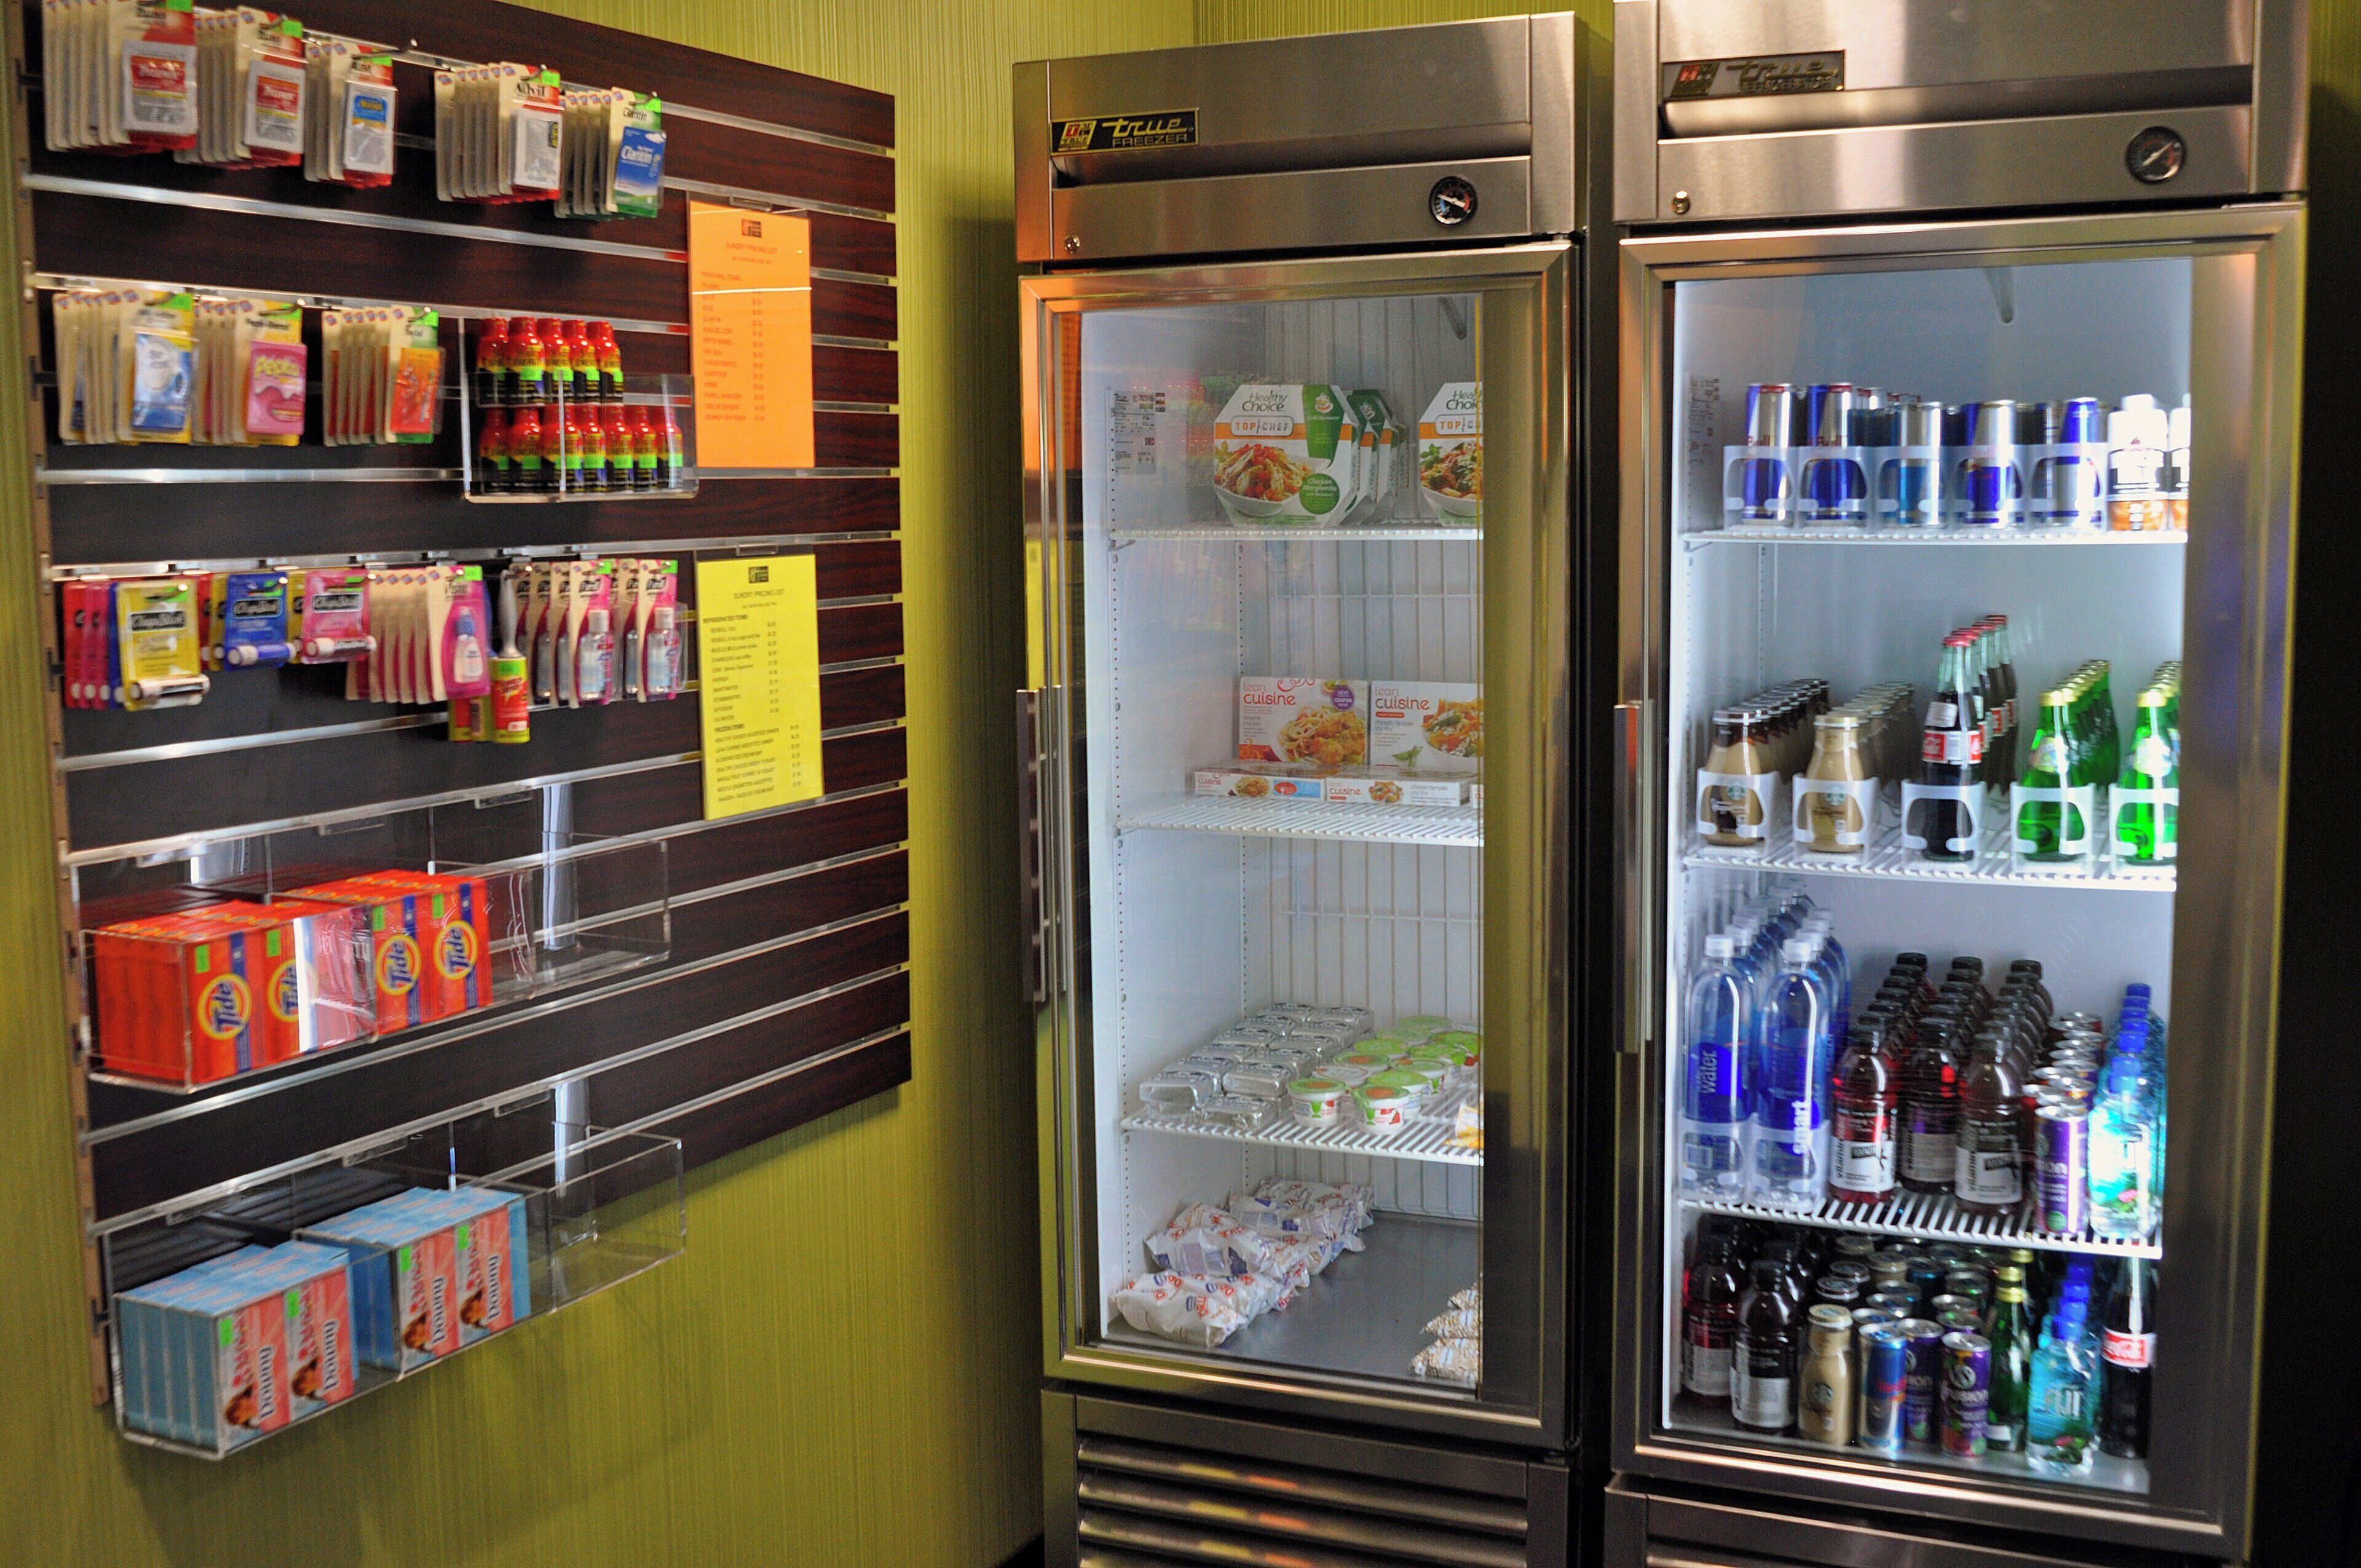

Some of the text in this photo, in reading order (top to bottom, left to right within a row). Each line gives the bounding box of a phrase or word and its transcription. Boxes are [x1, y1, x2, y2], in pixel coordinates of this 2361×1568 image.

[1102, 117, 1187, 138] true
[1112, 133, 1188, 148] FREEZER
[1249, 390, 1287, 403] Healthy
[1242, 400, 1284, 412] Choice
[1235, 422, 1289, 431] TOP CHEF
[1439, 421, 1461, 430] TOP
[1243, 682, 1267, 692] lean
[1243, 692, 1296, 706] cuisine
[1375, 696, 1430, 710] cuisine
[1329, 786, 1362, 796] cuisine
[444, 926, 472, 975] Tide
[386, 941, 413, 989] Tide
[212, 982, 243, 1033] Tide
[1701, 1049, 1718, 1094] water
[486, 1253, 502, 1321] Downy
[431, 1274, 448, 1345] Downy
[322, 1319, 340, 1392] Downy
[258, 1343, 276, 1420] Downy
